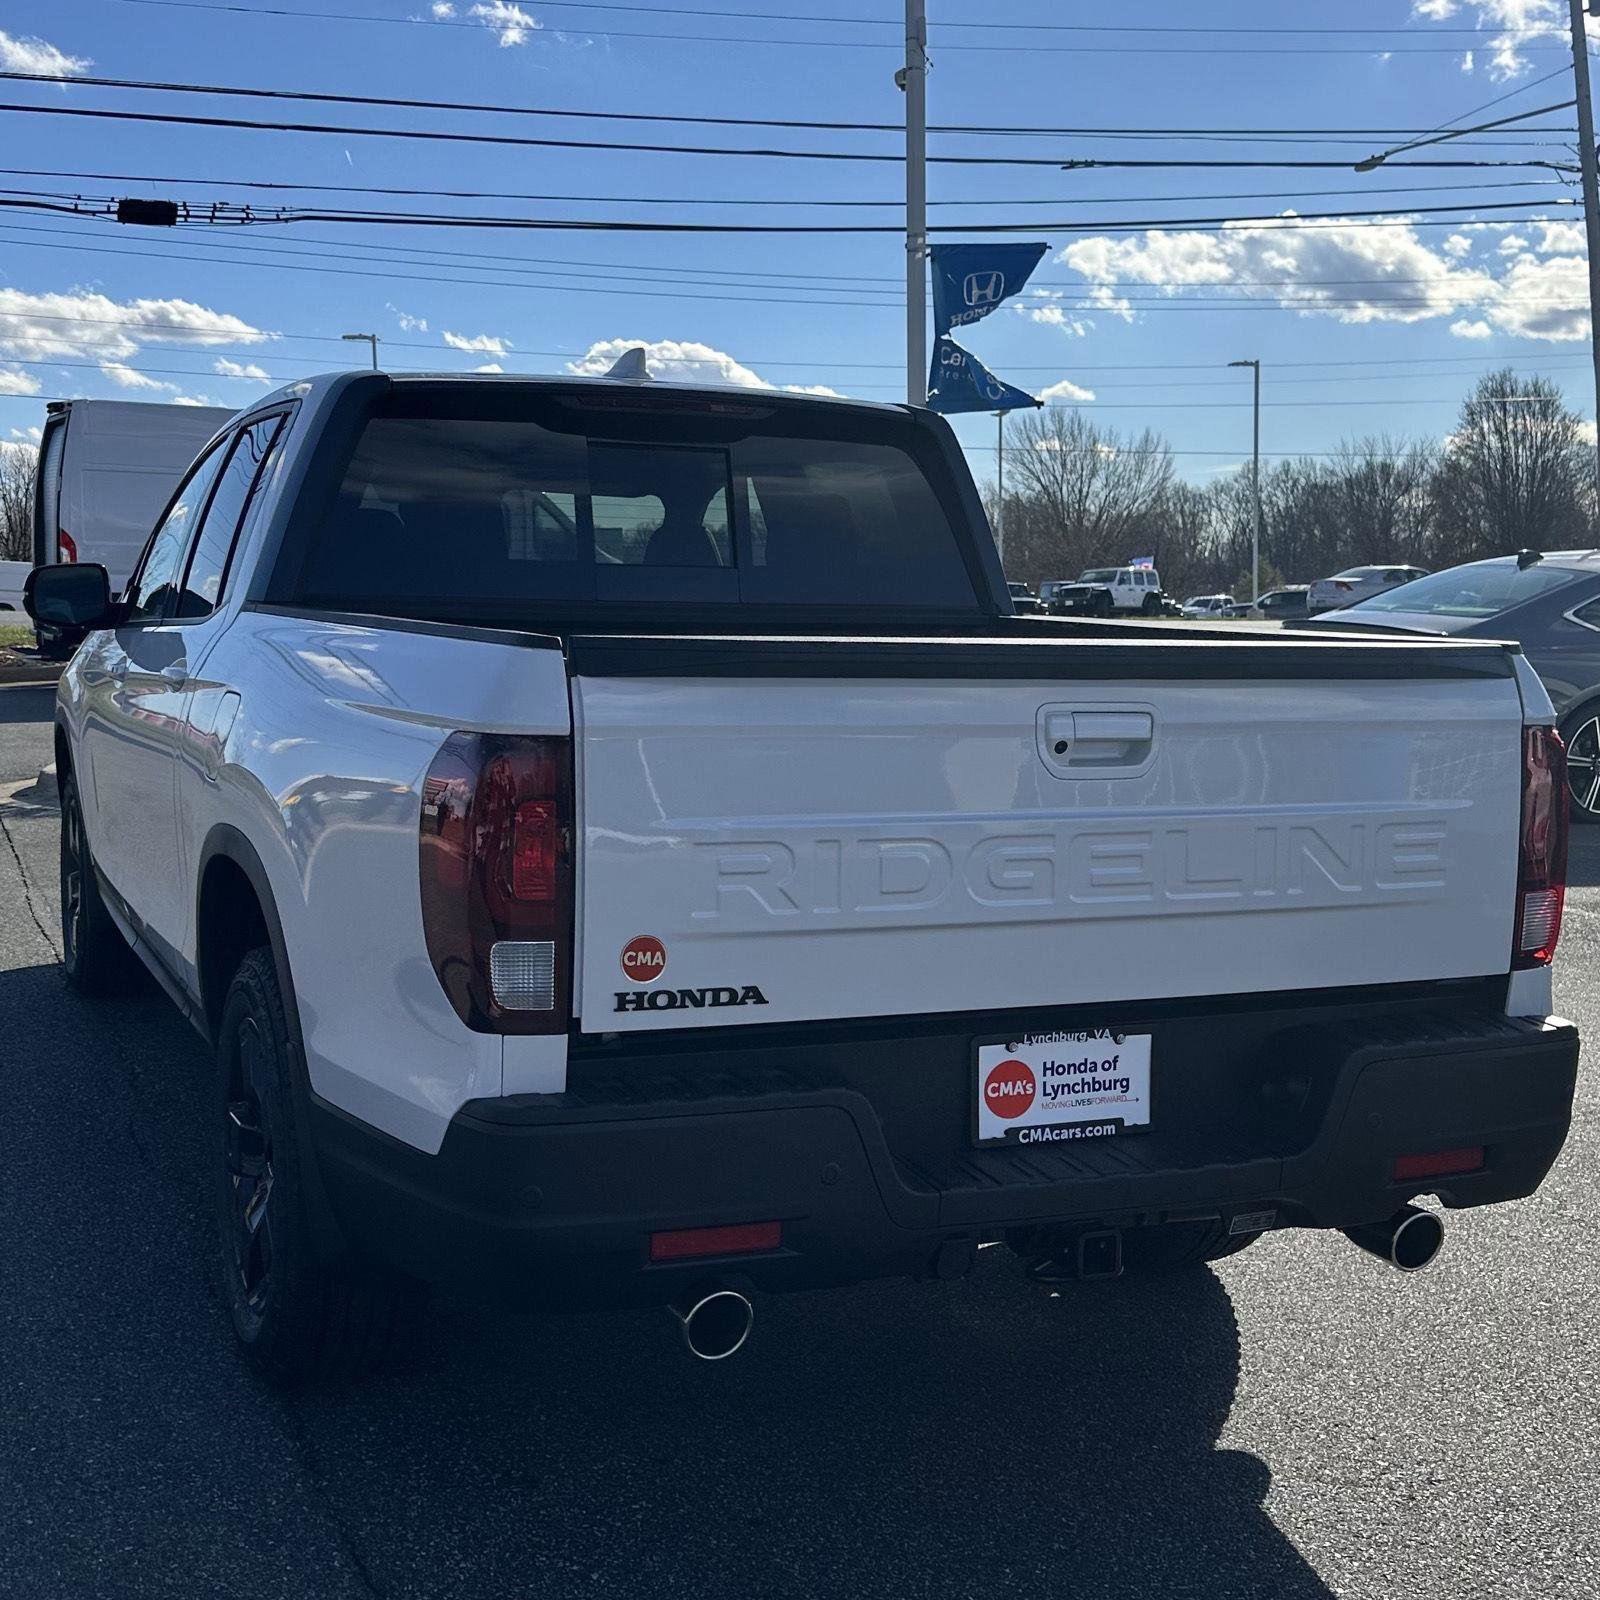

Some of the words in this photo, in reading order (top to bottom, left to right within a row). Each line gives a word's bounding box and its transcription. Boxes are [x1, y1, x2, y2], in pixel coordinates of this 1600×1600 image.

[692, 820, 1447, 918] RIDGELINE
[623, 951, 664, 967] CMA
[613, 985, 769, 1012] HONDA
[1023, 1031, 1090, 1047] Lynchburg,
[1094, 1028, 1112, 1040] VA
[1042, 1058, 1098, 1078] Honda
[1101, 1055, 1120, 1072] of
[987, 1079, 1034, 1098] CMA's
[1042, 1076, 1130, 1100] Lynchburg
[1018, 1124, 1116, 1144] CMAcars.com
